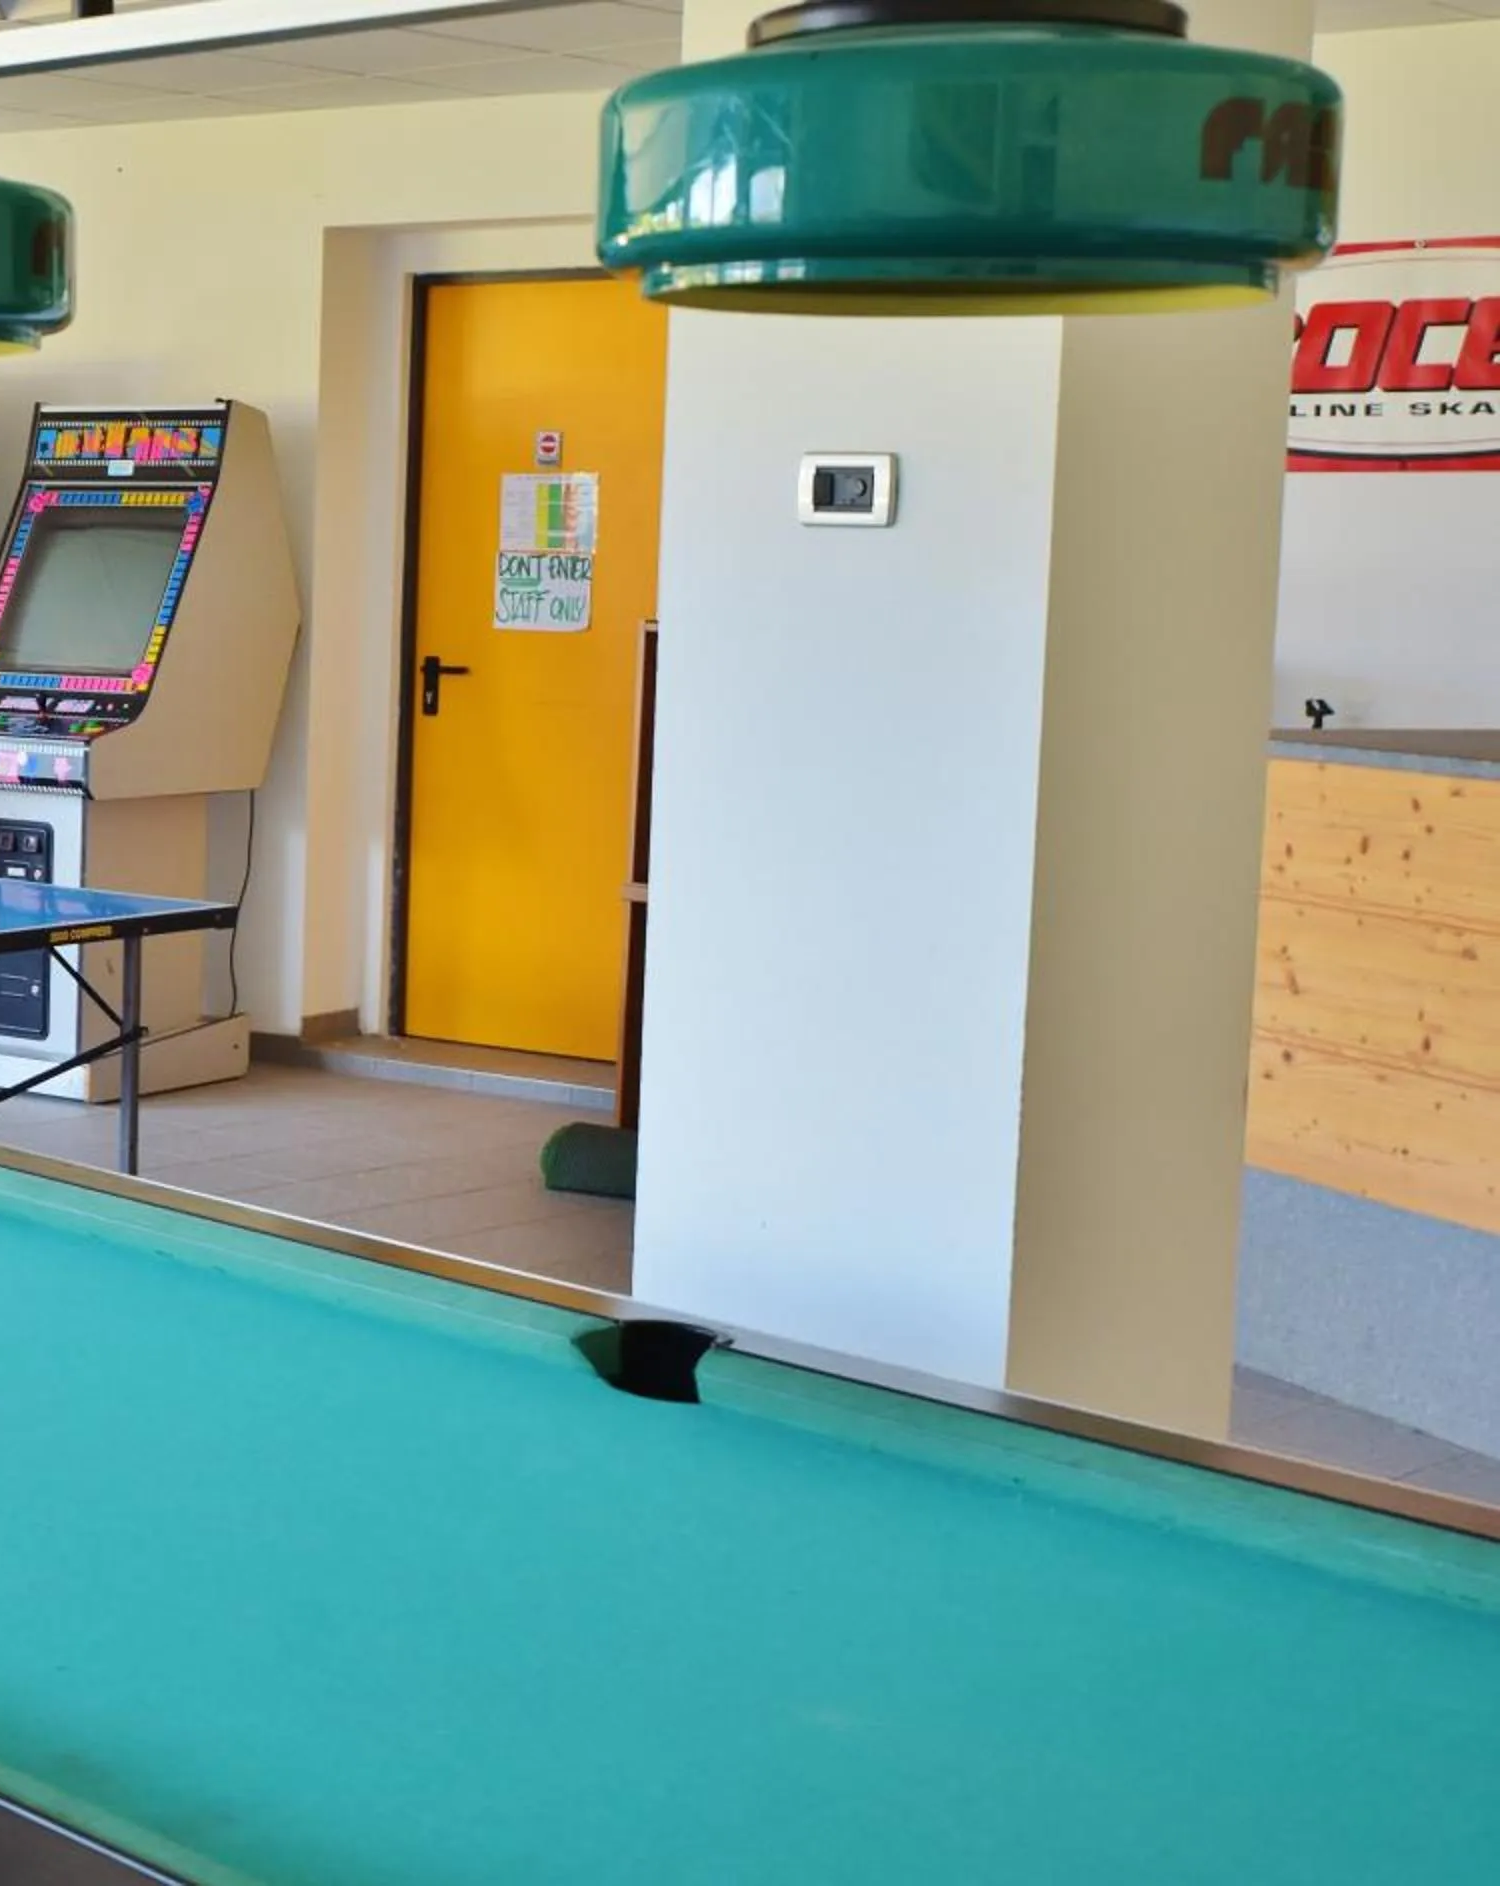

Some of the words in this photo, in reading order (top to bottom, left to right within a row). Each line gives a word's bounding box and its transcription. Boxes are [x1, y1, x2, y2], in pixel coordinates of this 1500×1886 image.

[1292, 297, 1500, 394] OCE
[1289, 404, 1384, 417] LINE
[1408, 401, 1495, 416] SKA
[548, 555, 592, 581] ENTER
